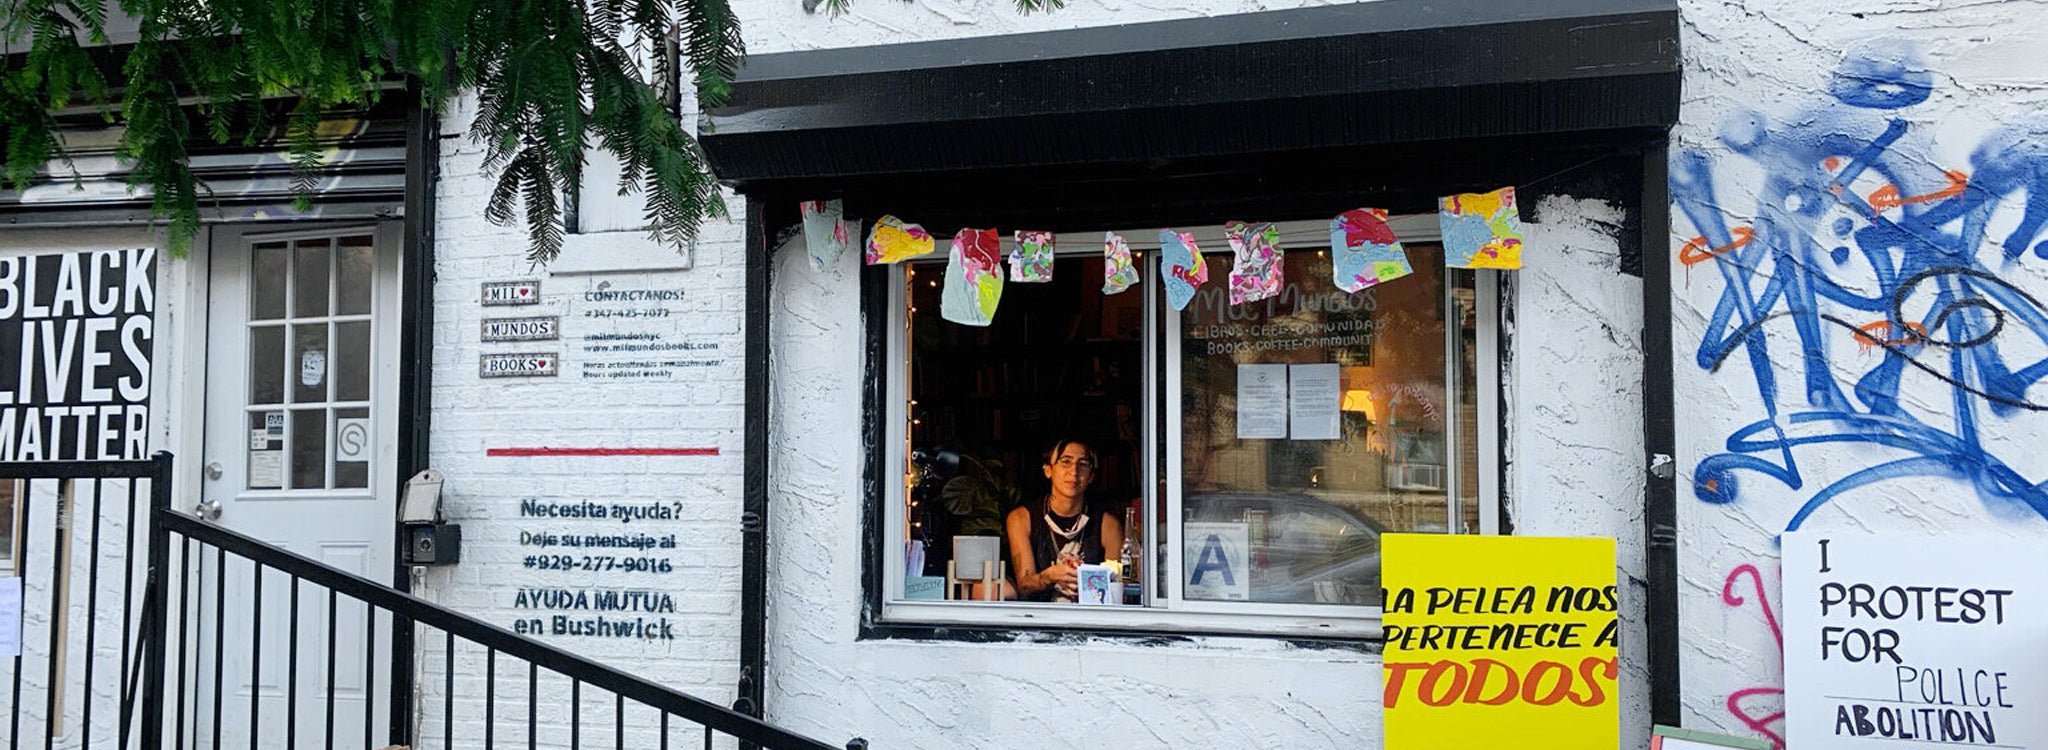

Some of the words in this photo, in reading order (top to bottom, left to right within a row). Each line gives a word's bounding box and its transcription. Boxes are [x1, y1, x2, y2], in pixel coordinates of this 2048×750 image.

[0, 248, 155, 320] BLACK
[491, 287, 519, 300] MIL
[491, 322, 549, 336] MUNDOS
[490, 359, 537, 372] BOOKS
[583, 370, 606, 379] Hours
[607, 369, 641, 380] updated
[643, 368, 673, 379] weekly
[520, 499, 607, 518] Necesita
[610, 500, 683, 523] ayuda?
[561, 535, 581, 548] su
[584, 533, 656, 550] mensaje
[1818, 539, 1831, 573] I
[523, 554, 673, 574] #929-277-9016
[1189, 534, 1237, 585] A
[514, 588, 589, 610] AYUDA
[594, 590, 675, 613] MUTUA
[1382, 587, 1414, 614] LA
[1426, 585, 1536, 615] PELEA
[1546, 585, 1618, 614] NOS
[1820, 582, 2014, 625] PROTEST
[513, 618, 544, 635] en
[552, 615, 675, 640] Bushwick
[1382, 622, 1587, 653] PERTENECE
[1593, 619, 1618, 648] A
[1820, 626, 1903, 664] FOR
[1383, 656, 1618, 708] TODOS
[1896, 666, 2014, 708] POLICE
[1835, 705, 1996, 744] ABOLITION
